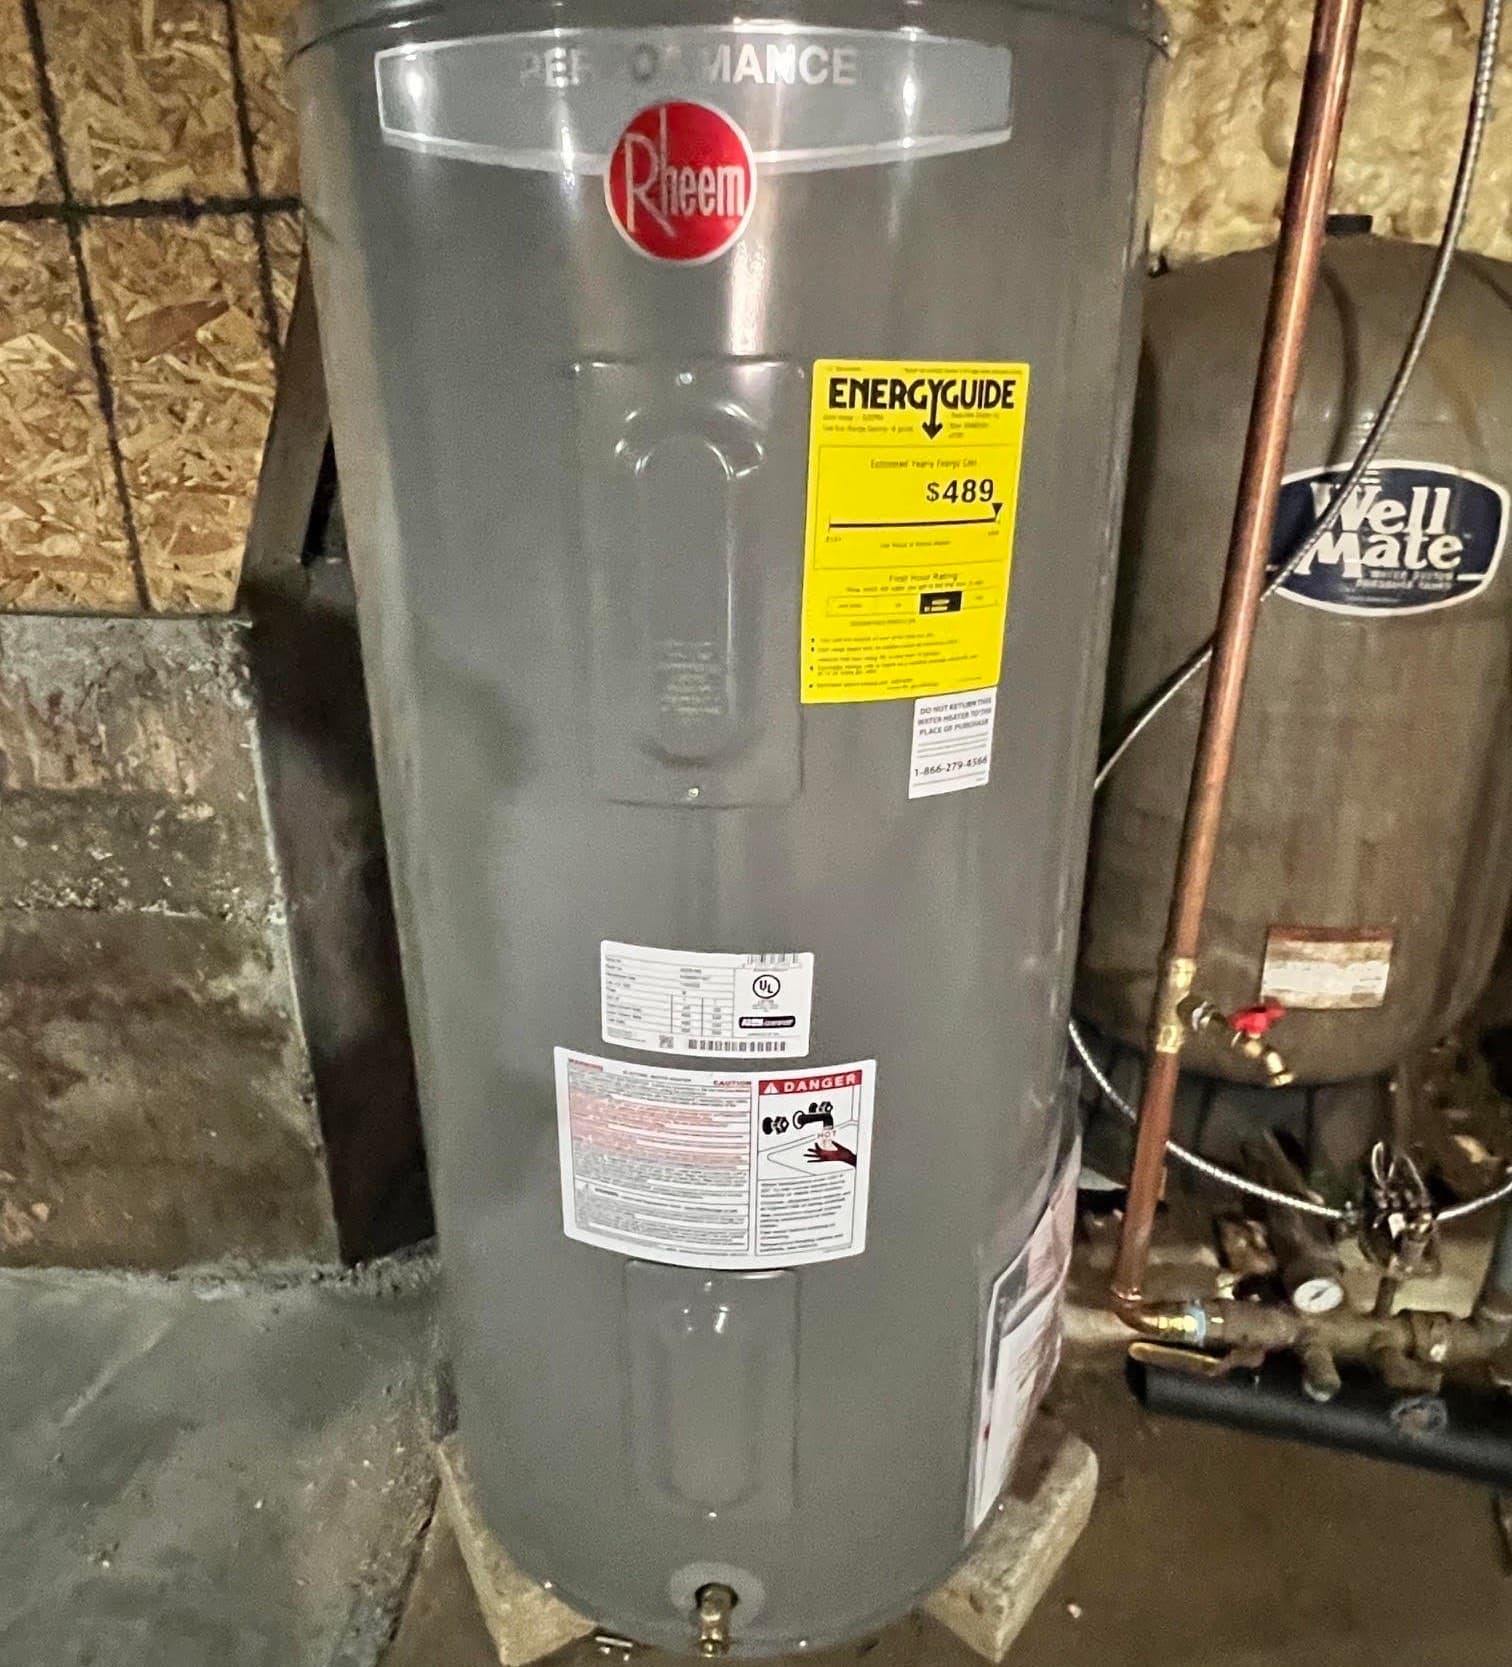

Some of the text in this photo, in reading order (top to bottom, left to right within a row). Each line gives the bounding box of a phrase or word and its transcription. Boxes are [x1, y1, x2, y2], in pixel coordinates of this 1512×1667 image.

[624, 106, 746, 238] Rheem
[829, 378, 1016, 410] ENERGYGUIDE
[926, 478, 994, 504] $489
[1310, 482, 1451, 535] Well
[1294, 531, 1464, 578] Mate
[920, 706, 932, 715] DO
[932, 704, 949, 713] NOT
[919, 726, 942, 736] PLACE
[943, 724, 953, 732] OF
[783, 1073, 857, 1093] DANGER
[816, 1130, 837, 1138] HOT
